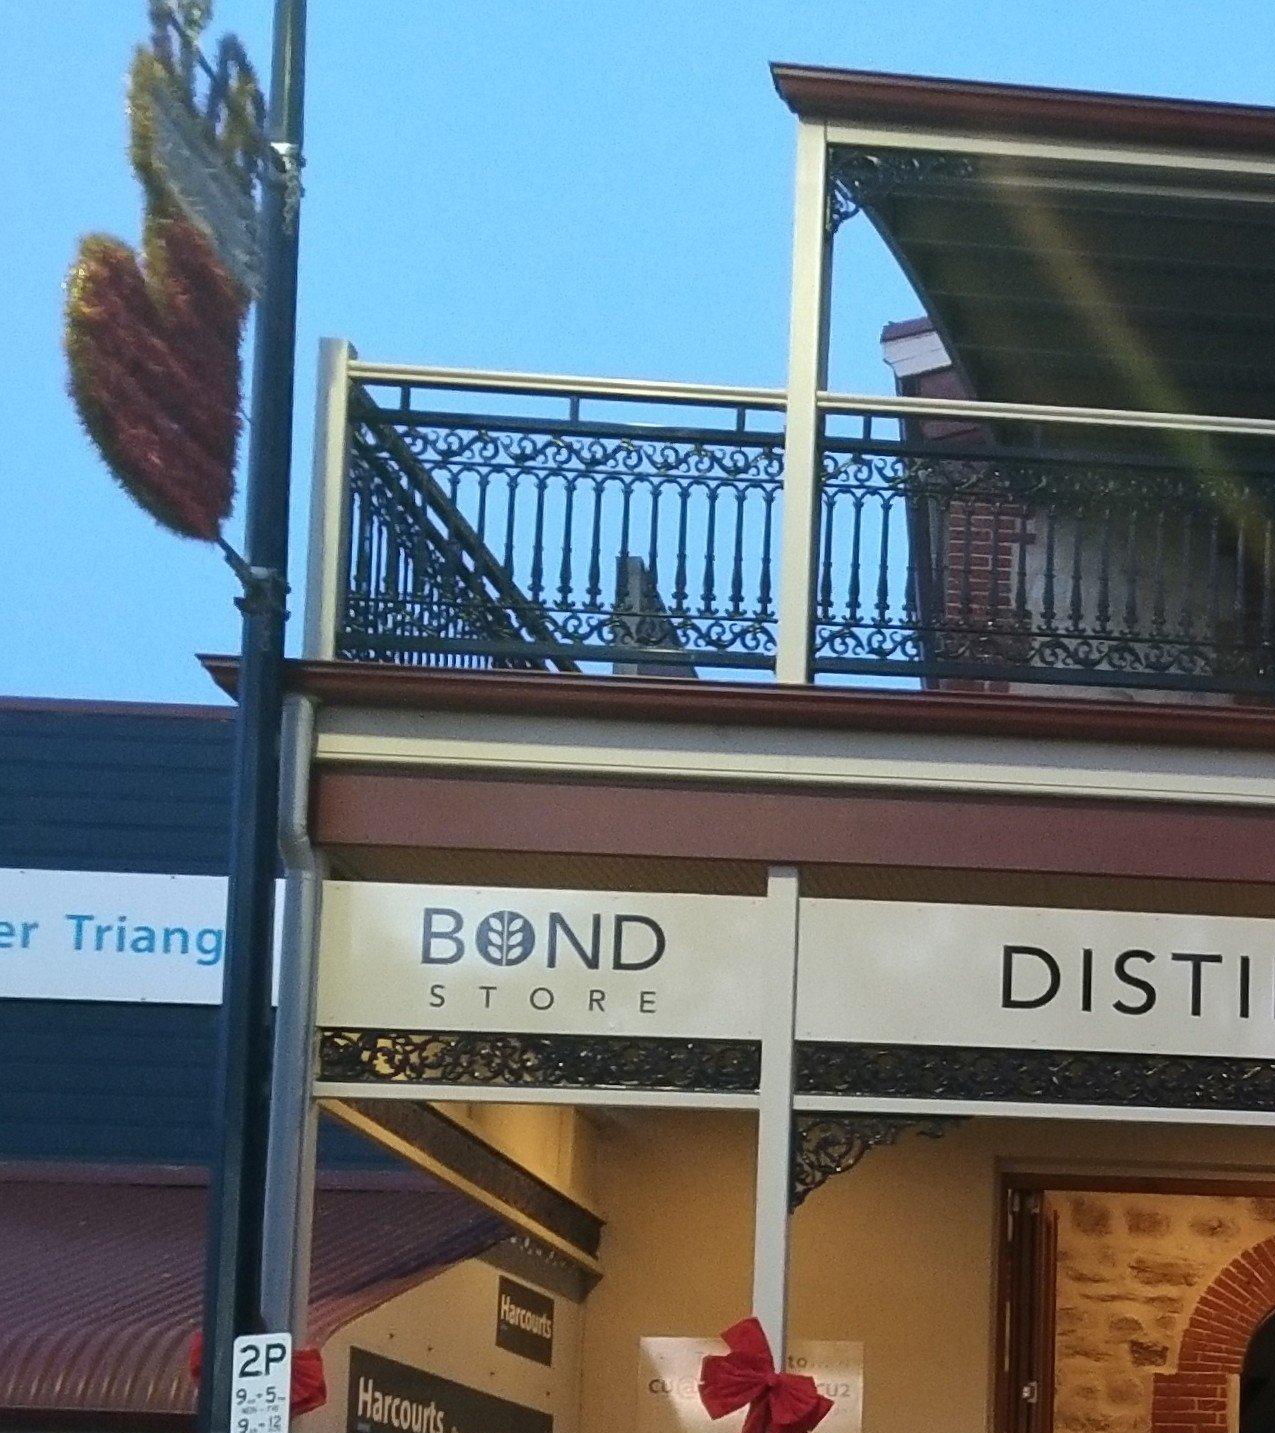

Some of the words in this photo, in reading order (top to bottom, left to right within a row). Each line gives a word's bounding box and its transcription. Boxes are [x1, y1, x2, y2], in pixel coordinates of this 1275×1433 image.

[65, 914, 225, 966] Triang
[421, 907, 666, 971] BOND
[429, 984, 657, 1014] STORE
[501, 1294, 552, 1339] Harcourts
[238, 1343, 287, 1379] 2P
